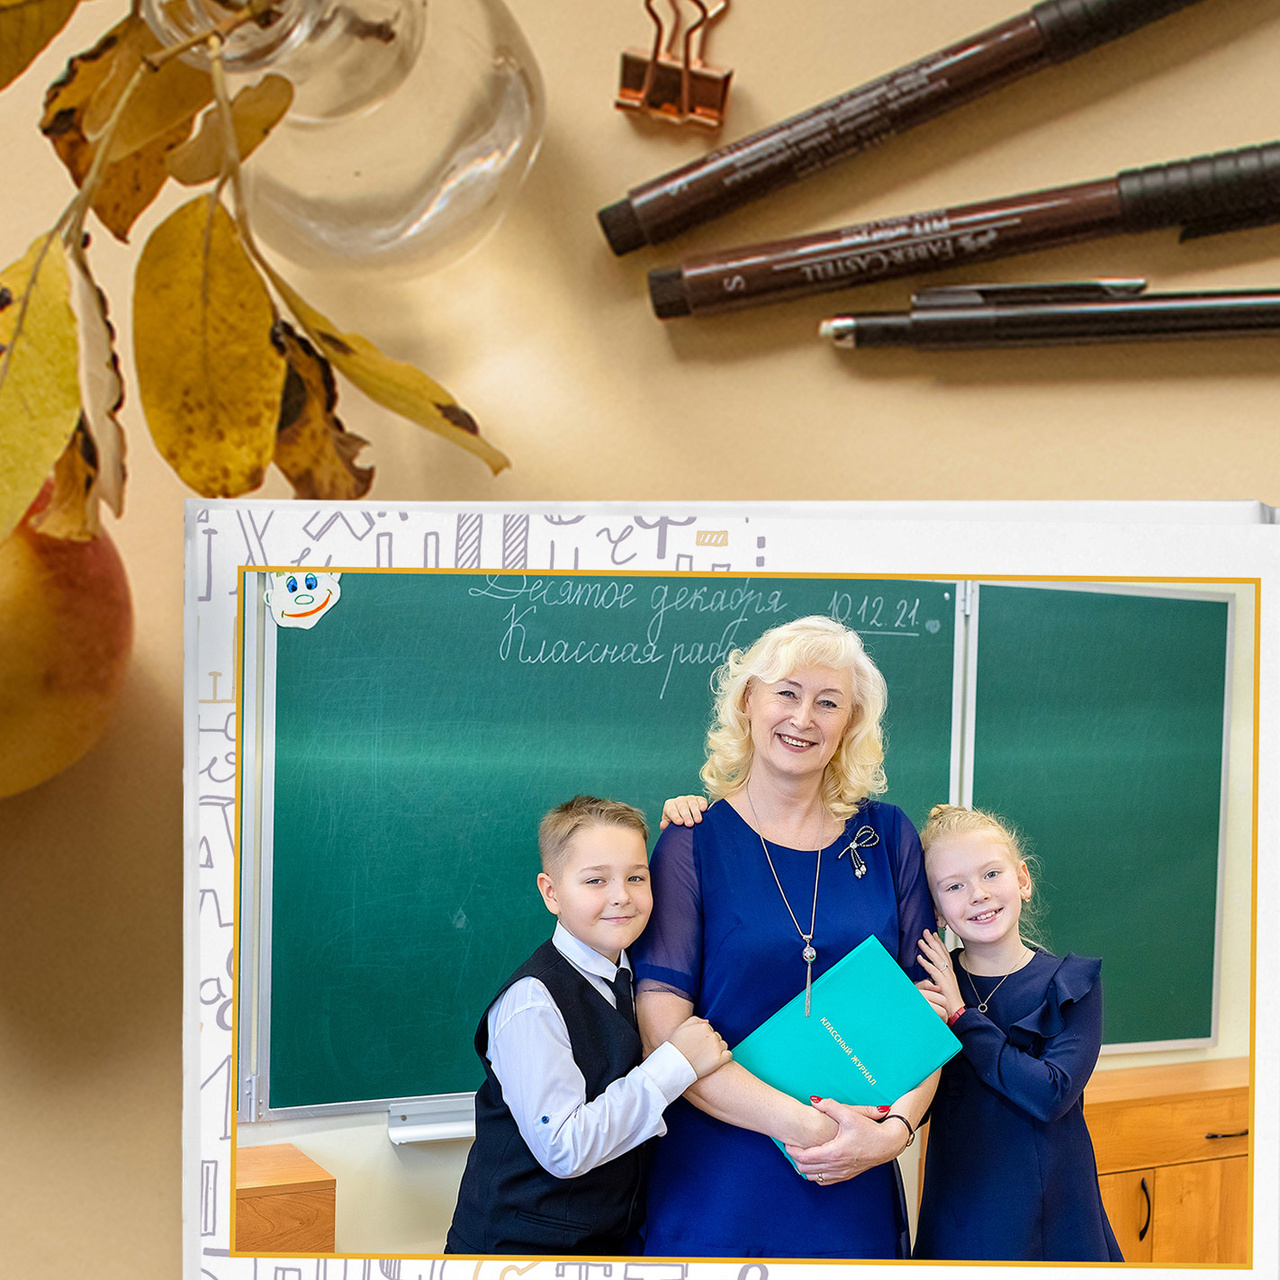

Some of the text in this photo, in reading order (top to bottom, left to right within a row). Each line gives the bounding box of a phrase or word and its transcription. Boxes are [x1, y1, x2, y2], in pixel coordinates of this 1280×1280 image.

[500, 603, 665, 664] Классная
[647, 578, 788, 646] декабря
[819, 1016, 877, 1087] КЛАССНЫЙ ЖУРНАЛ
